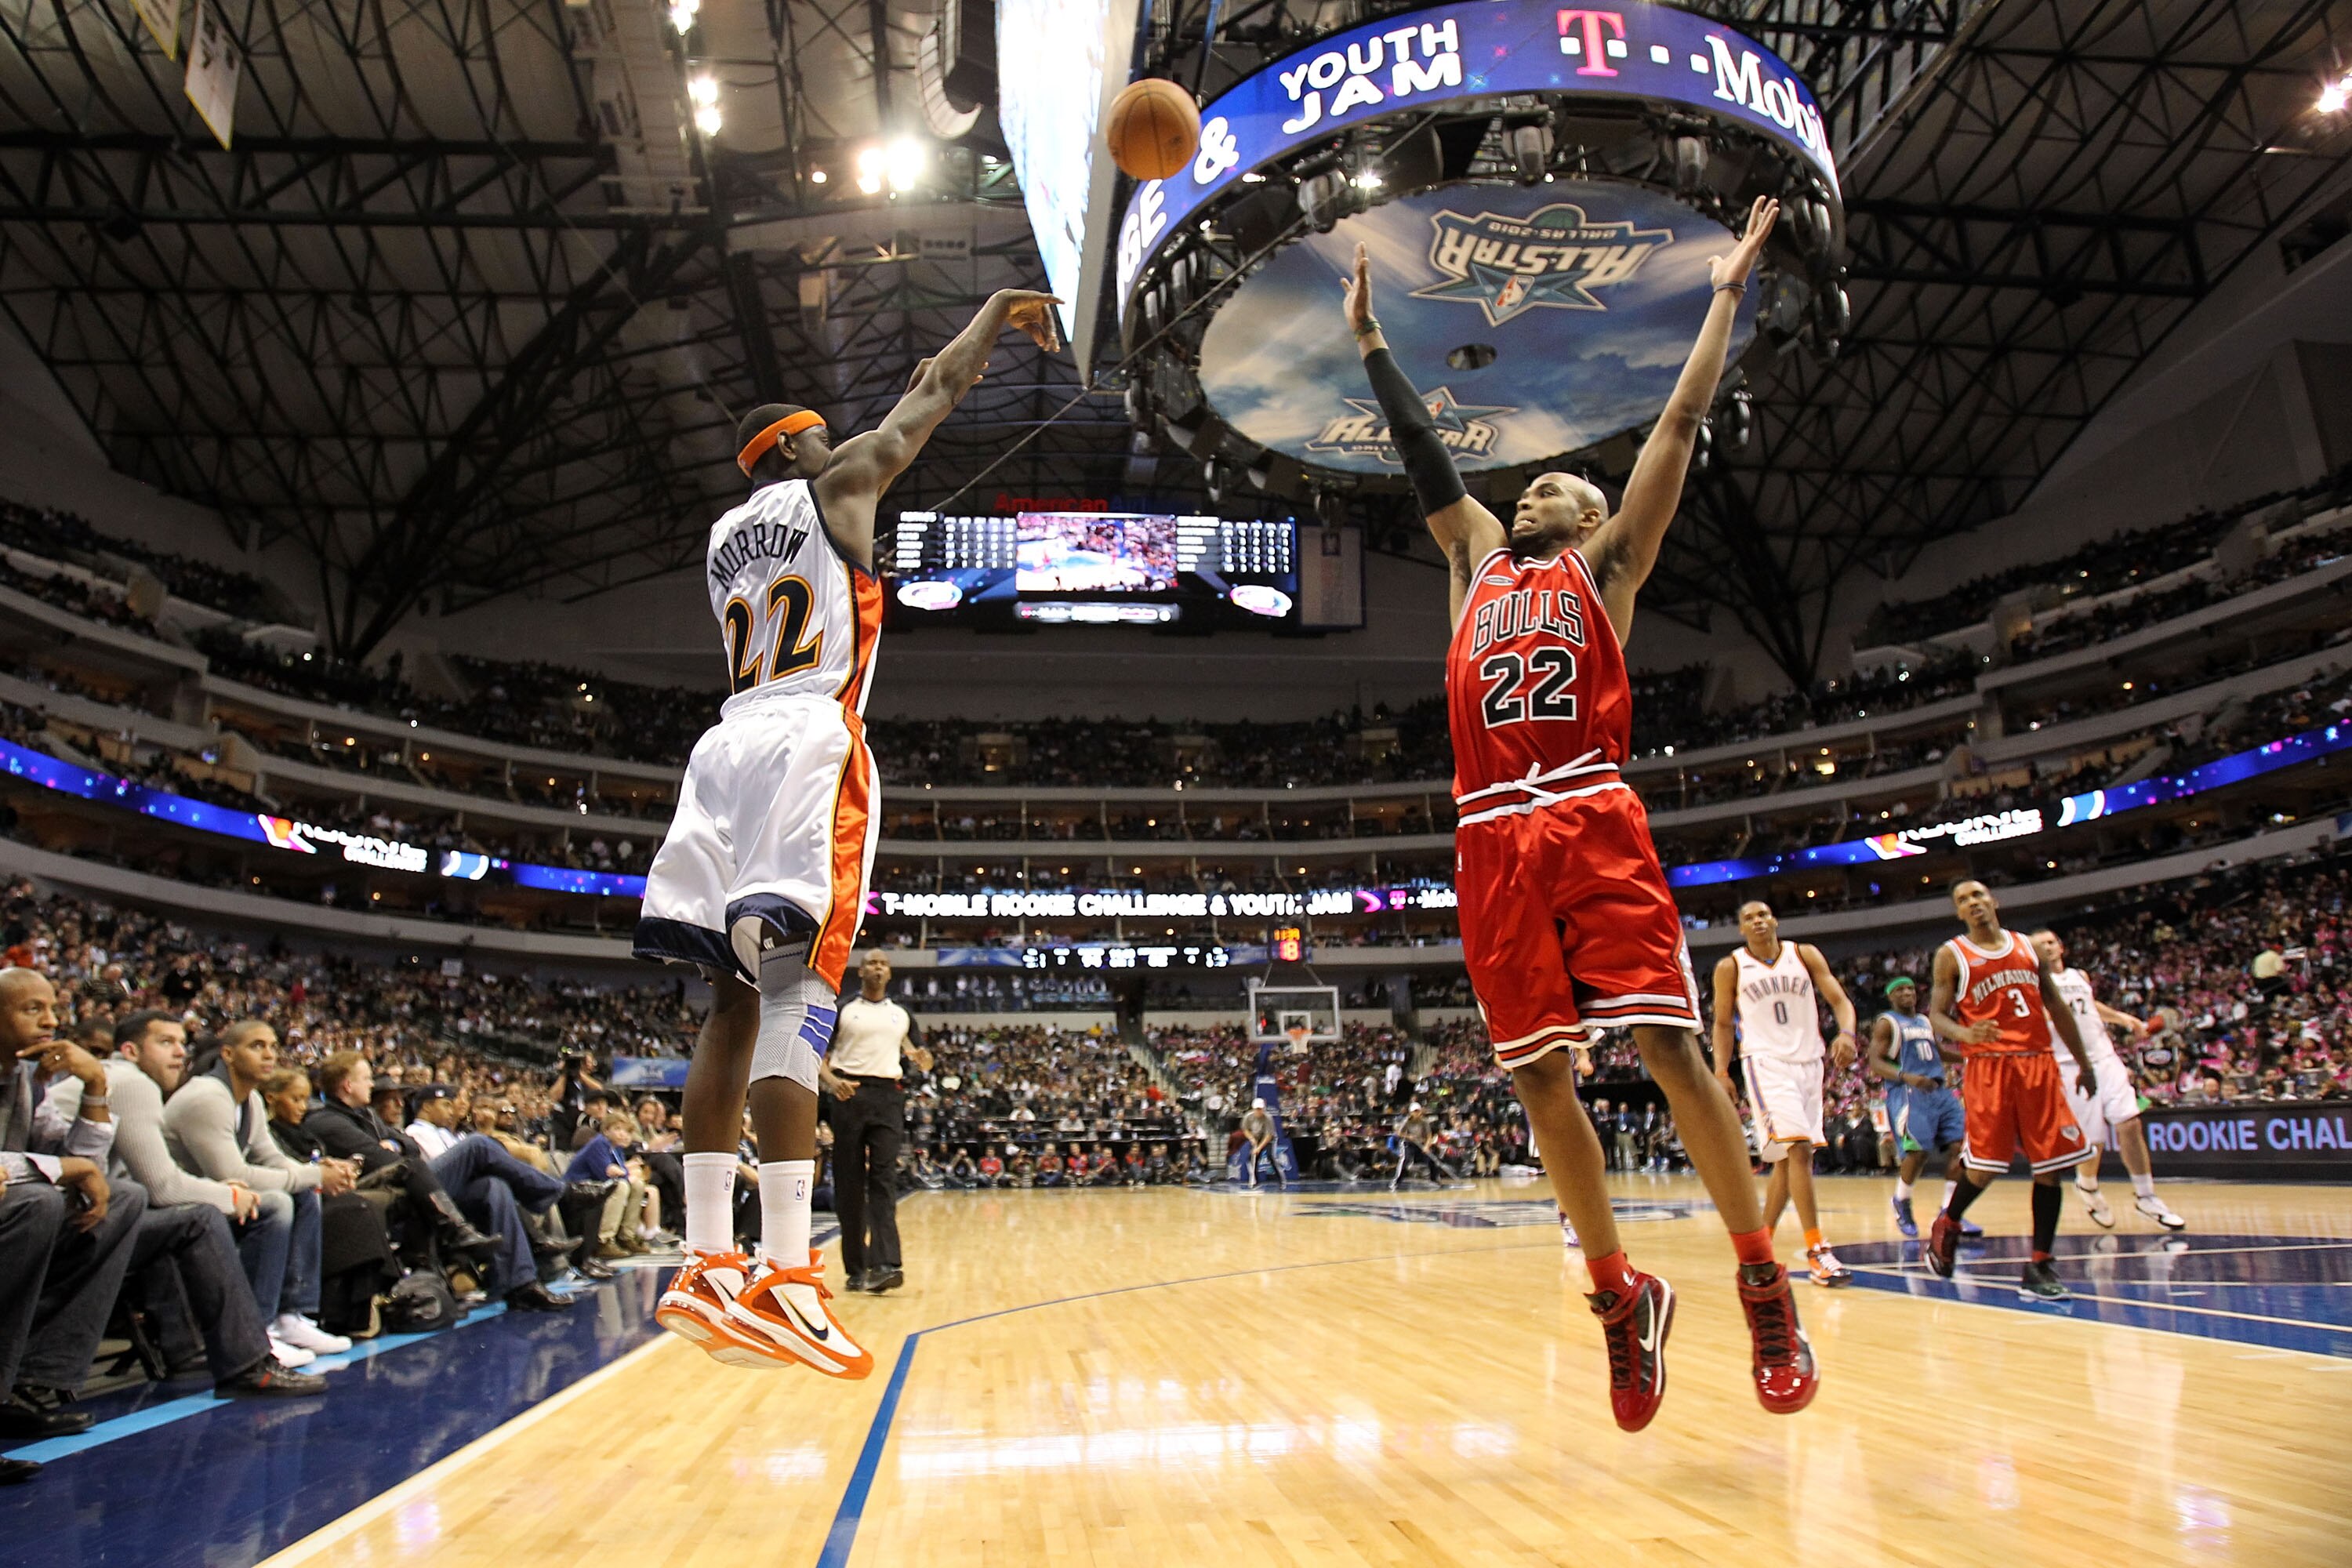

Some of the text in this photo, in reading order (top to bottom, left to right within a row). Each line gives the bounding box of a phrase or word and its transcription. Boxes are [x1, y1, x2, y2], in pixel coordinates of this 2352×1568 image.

[1279, 19, 1459, 101] YOUTH
[1282, 52, 1462, 134] JAM
[1193, 117, 1240, 185] &
[710, 522, 810, 593] MORROW
[724, 575, 824, 695] 22
[1468, 587, 1586, 662] BULLS
[1480, 645, 1577, 730] 22
[881, 892, 989, 916] T-MOBILE
[1743, 975, 1810, 1003] THUNDER
[1774, 1001, 1788, 1025] 0
[2006, 988, 2031, 1018] 3
[1916, 1040, 1934, 1062] 10
[2147, 1120, 2259, 1152] ROOKIE
